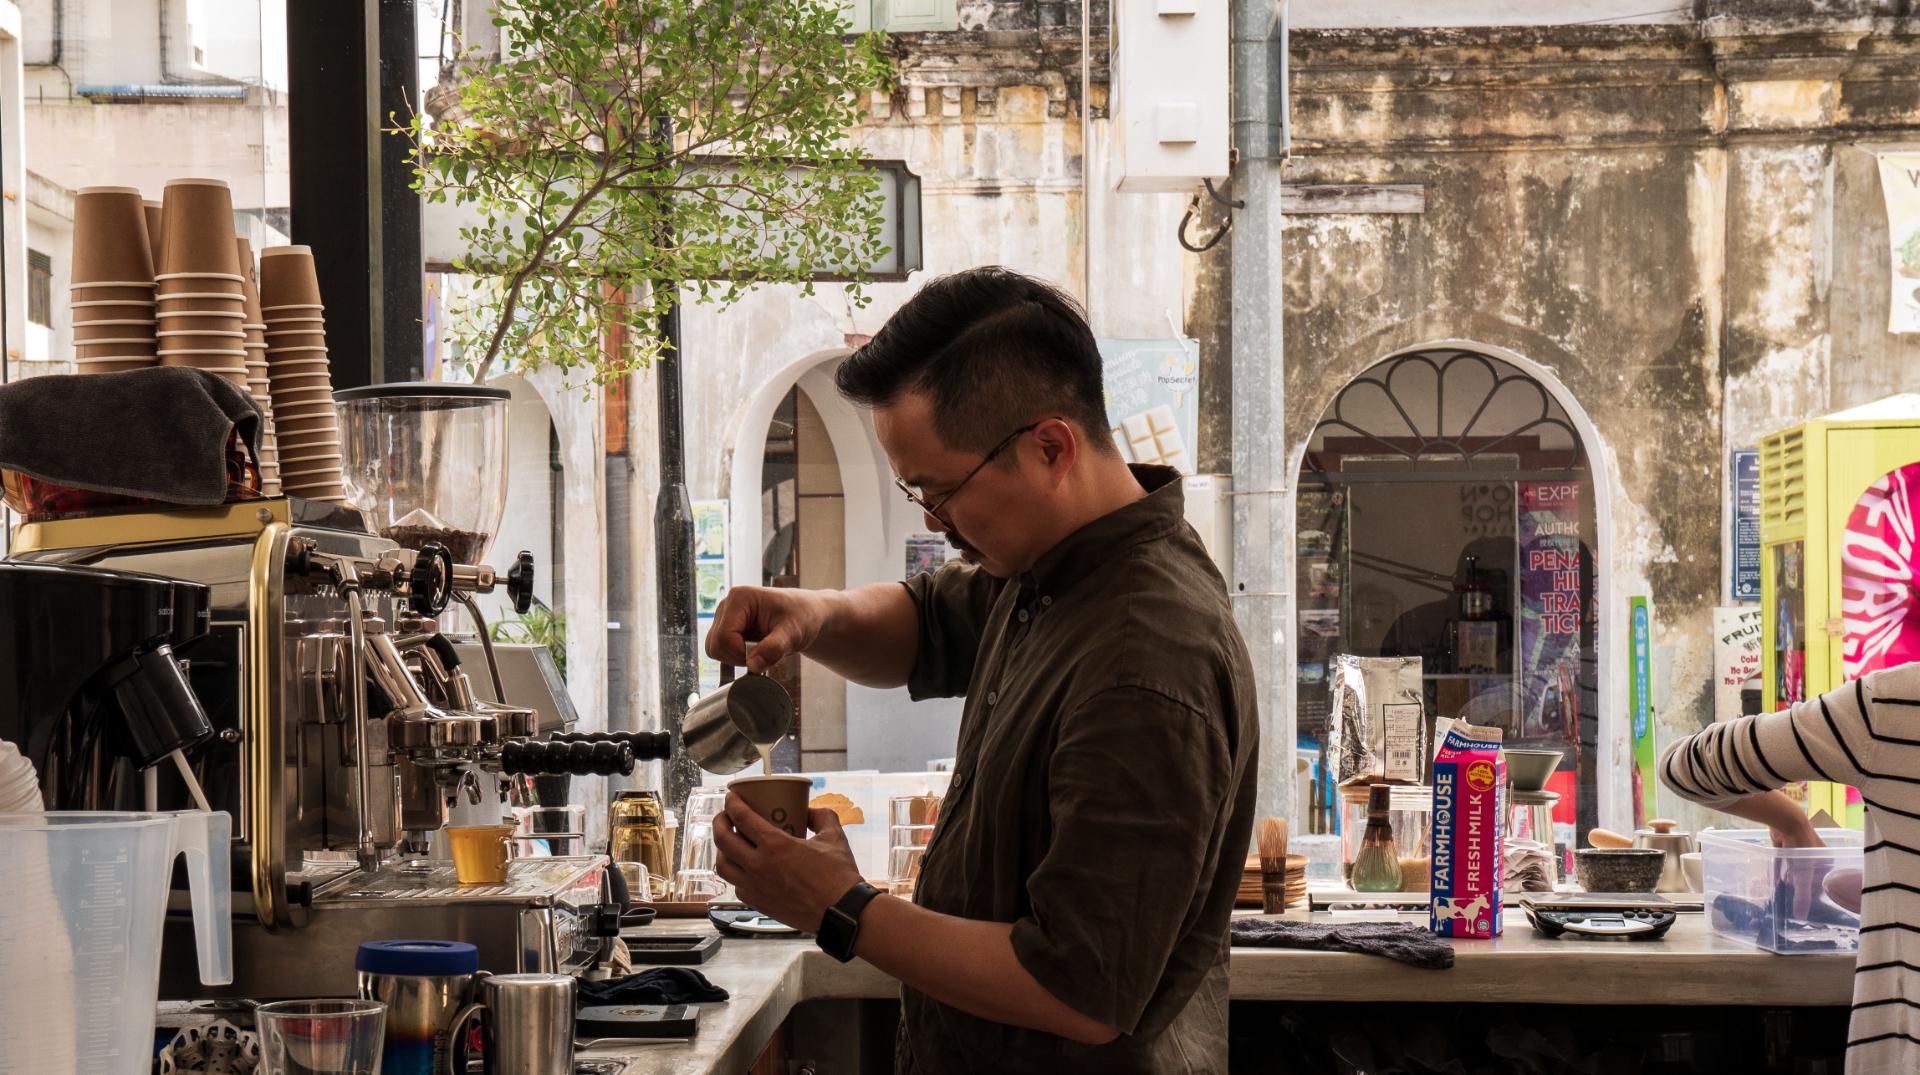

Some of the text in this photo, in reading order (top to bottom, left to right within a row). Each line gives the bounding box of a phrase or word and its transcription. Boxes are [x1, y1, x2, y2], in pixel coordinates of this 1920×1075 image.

[1722, 624, 1762, 645] FRUI
[1447, 735, 1498, 749] FARMHOUSE
[1435, 773, 1452, 890] FARMHOUSE
[1467, 794, 1482, 892] FRESH MILK
